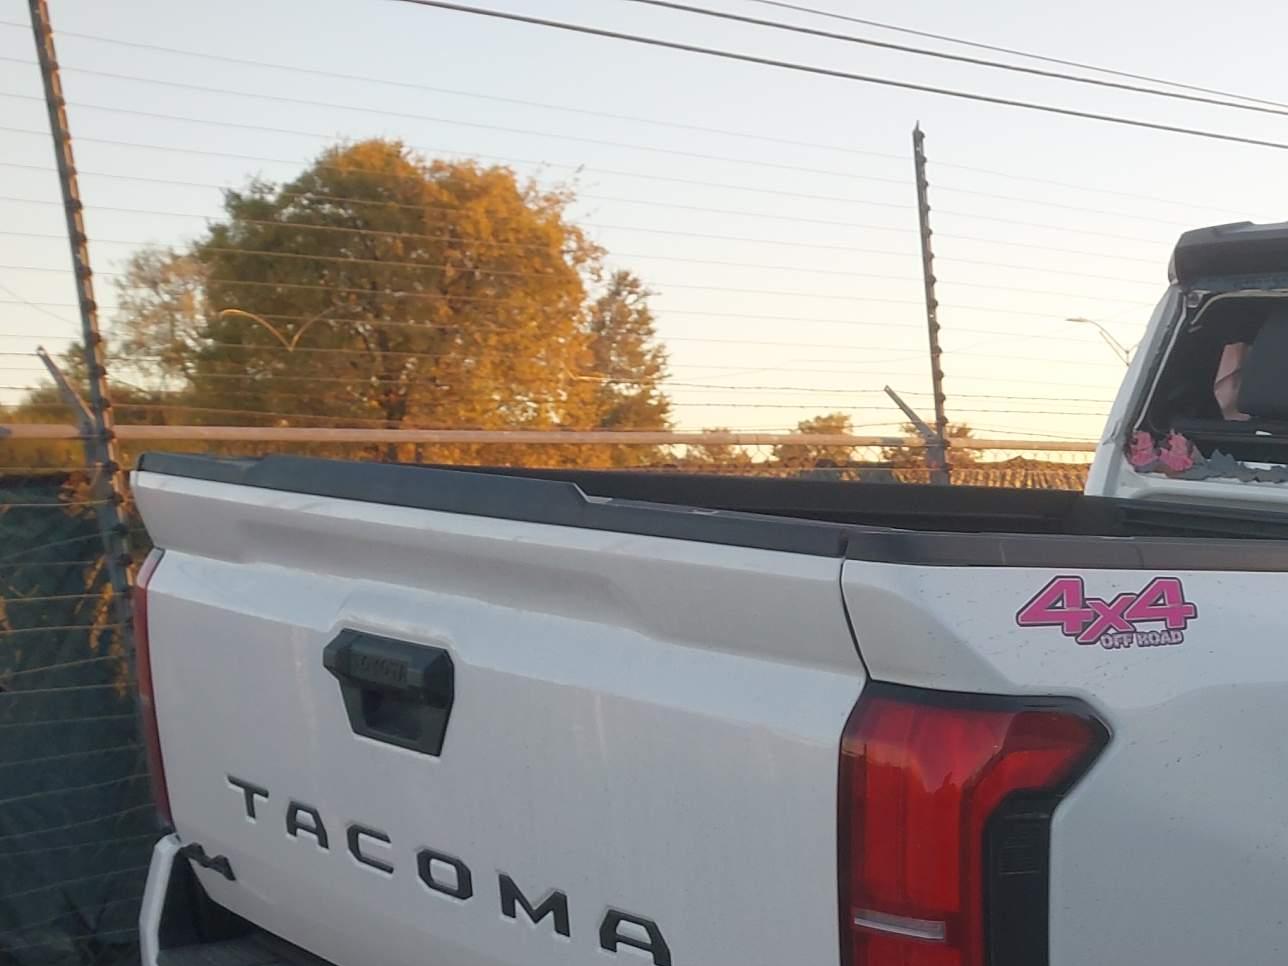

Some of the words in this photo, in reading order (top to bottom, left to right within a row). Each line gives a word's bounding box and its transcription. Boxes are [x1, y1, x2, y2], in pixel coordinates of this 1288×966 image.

[1017, 576, 1198, 645] 4x4
[1101, 632, 1134, 650] OFF
[1136, 630, 1185, 647] ROAD
